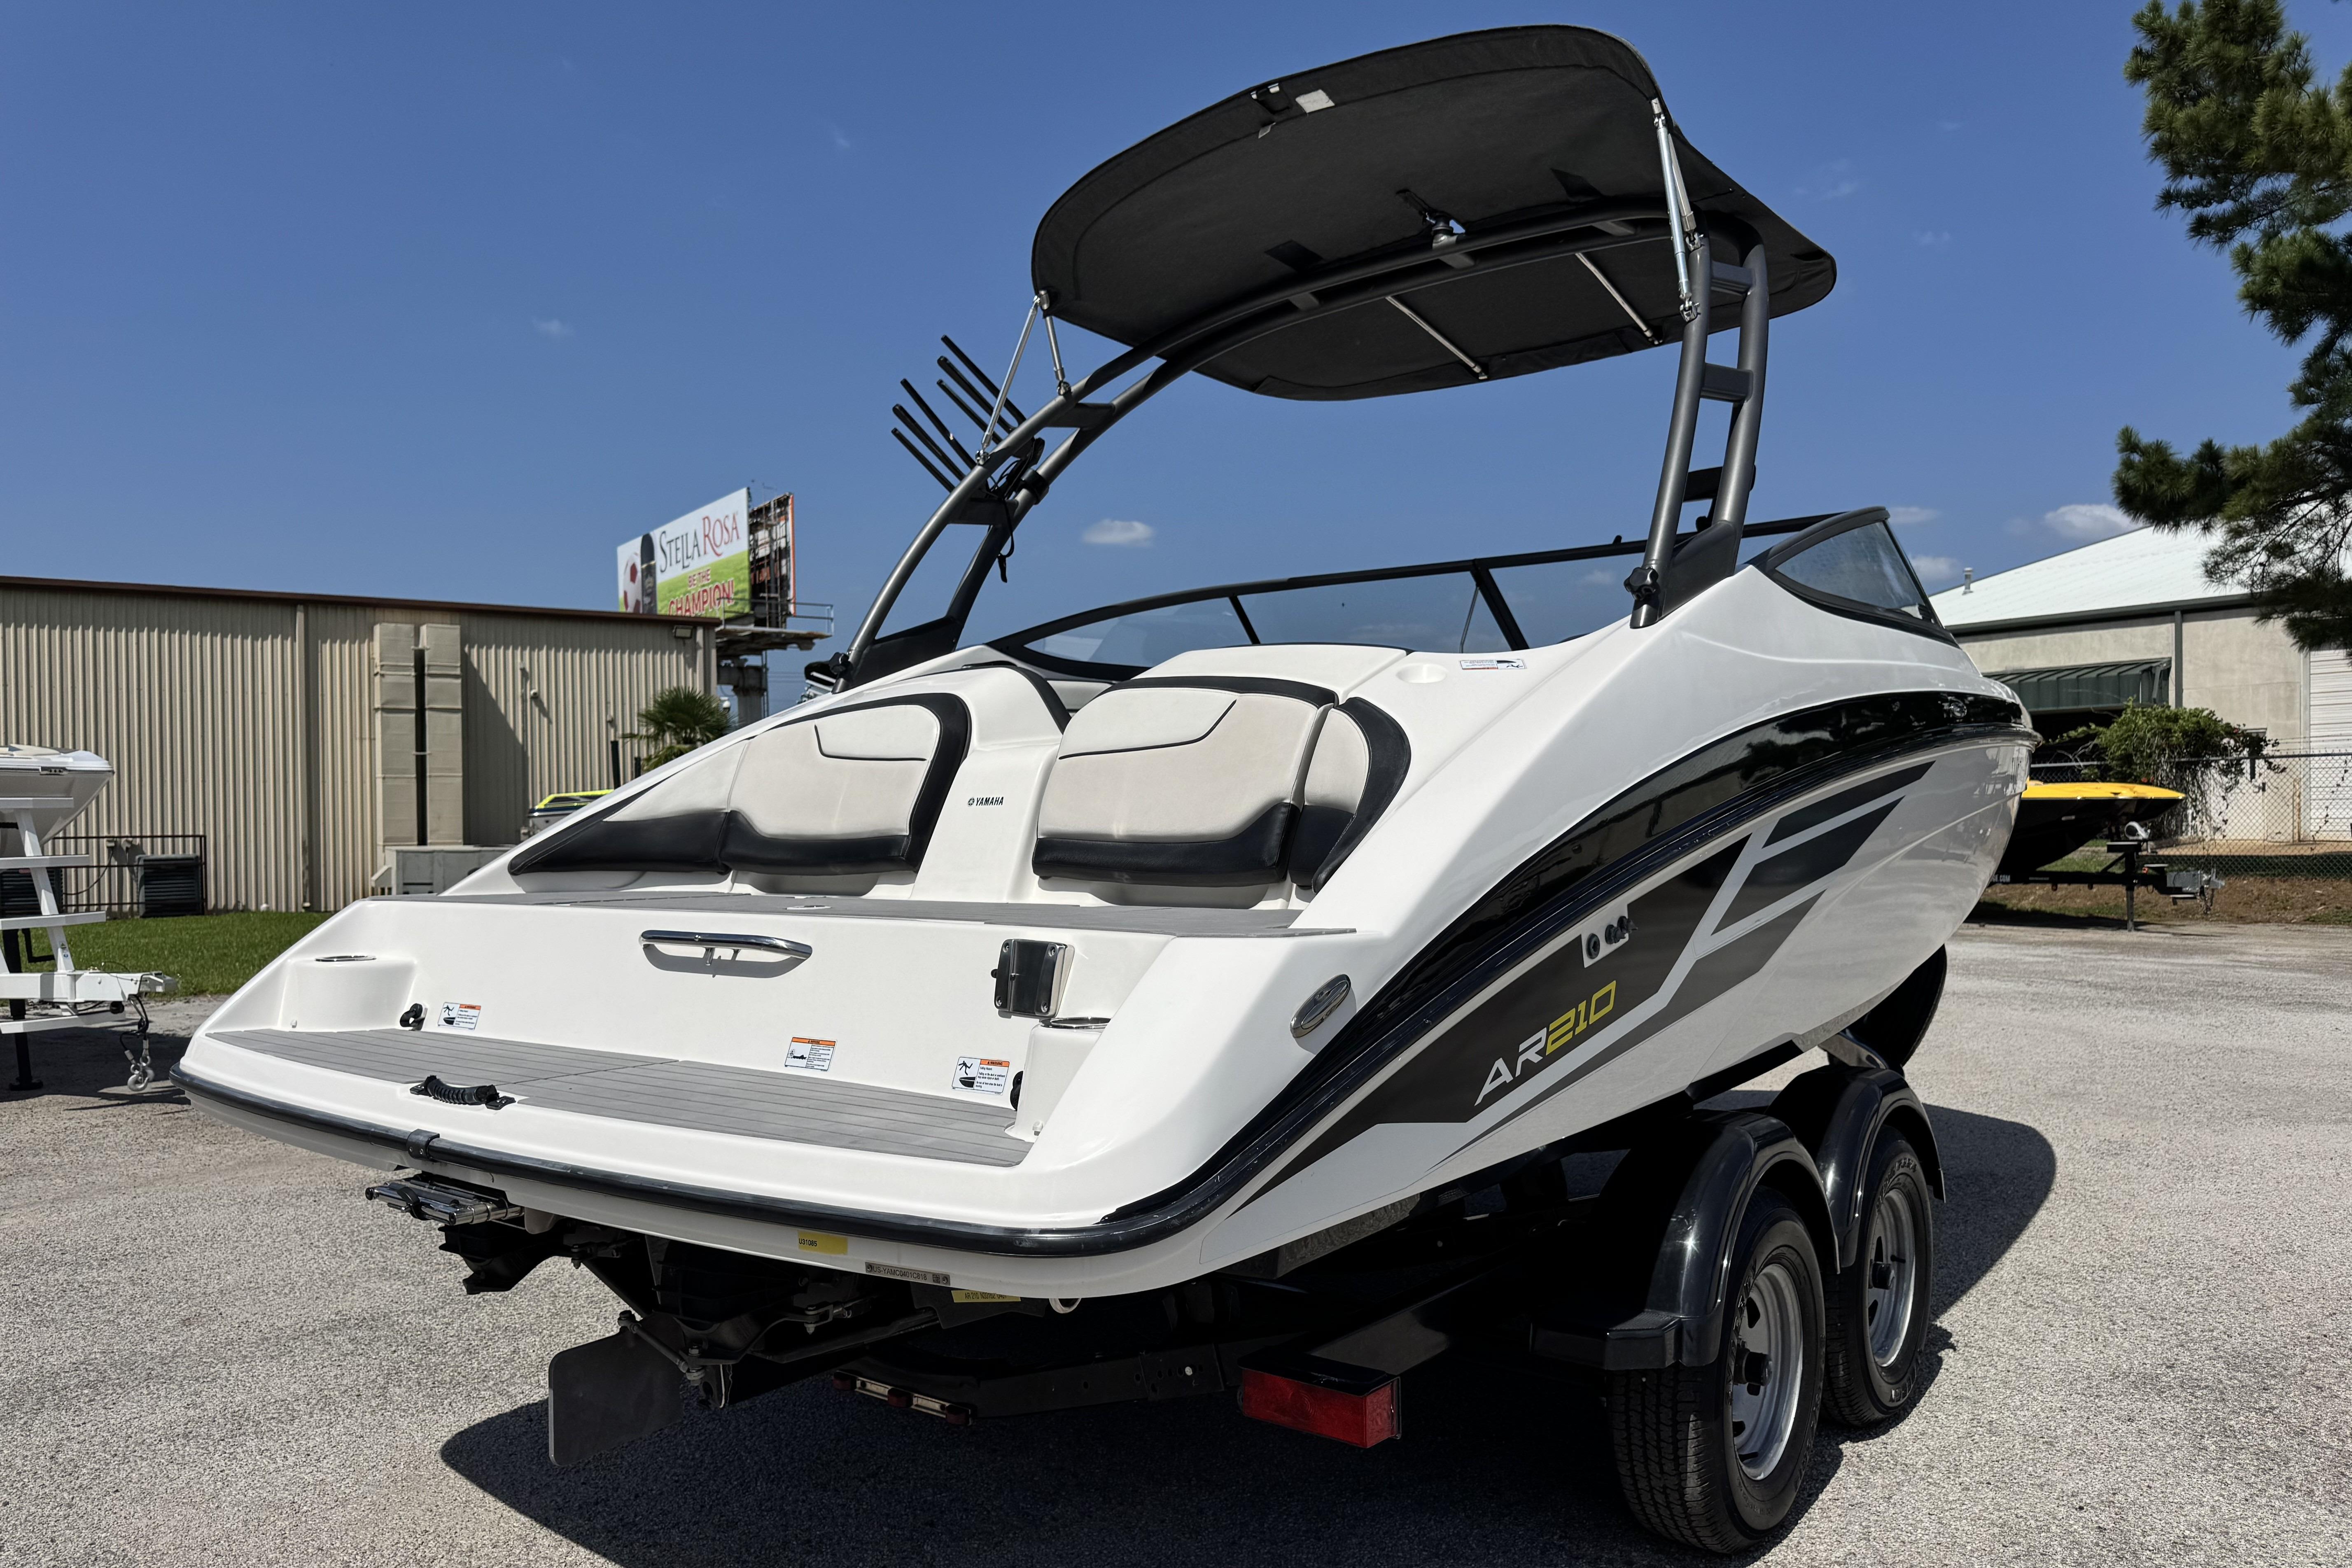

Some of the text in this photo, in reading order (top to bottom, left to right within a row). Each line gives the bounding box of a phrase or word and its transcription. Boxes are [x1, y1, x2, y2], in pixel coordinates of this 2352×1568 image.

[660, 513, 740, 573] STELLA ROSA
[976, 797, 1003, 806] YAMAHA
[1474, 980, 1616, 1106] AR210
[799, 1238, 817, 1246] U31085
[873, 1266, 927, 1281] US-YAMC0401C818
